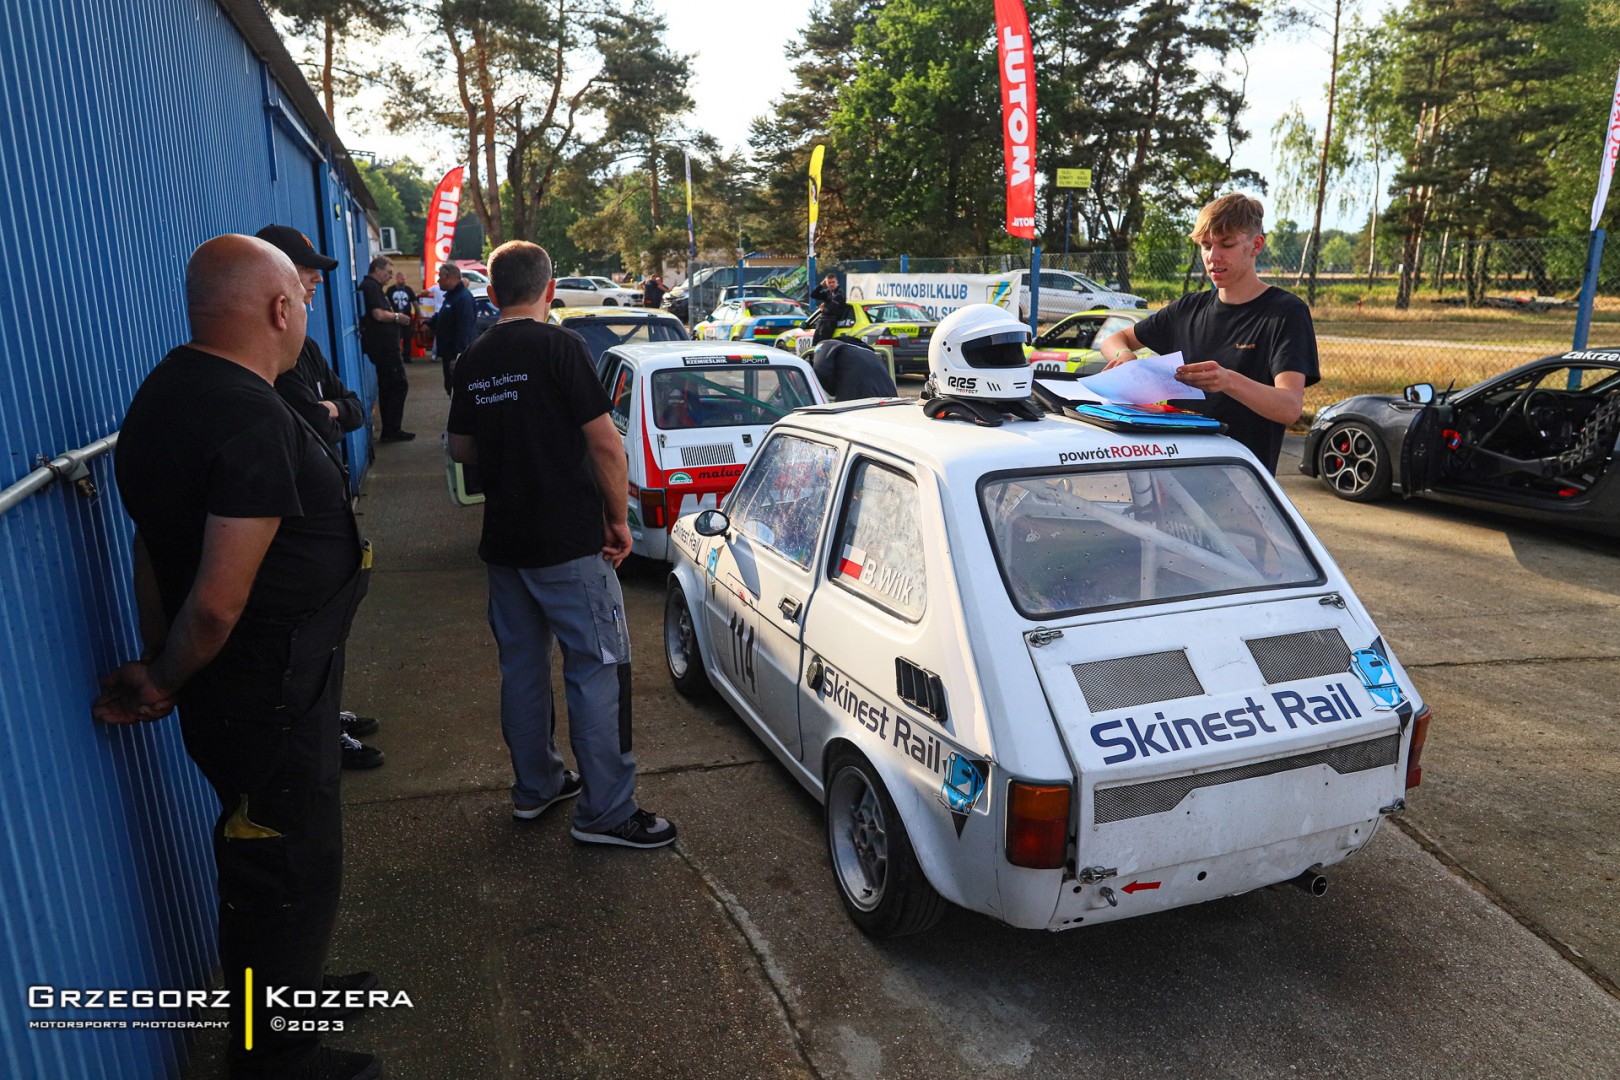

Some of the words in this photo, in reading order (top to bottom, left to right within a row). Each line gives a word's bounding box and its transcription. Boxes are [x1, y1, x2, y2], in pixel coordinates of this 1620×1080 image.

[876, 283, 968, 300] AUTOMOBILKLUB
[1561, 350, 1620, 361] Zakrze
[948, 376, 977, 389] RRS
[1059, 444, 1179, 465] powrótROBKA.pl
[698, 466, 746, 479] maluc
[729, 610, 756, 694] 114
[823, 666, 889, 740] Skinest
[893, 715, 941, 774] Rail
[1090, 697, 1276, 765] Skinest
[1271, 683, 1362, 729] Rail
